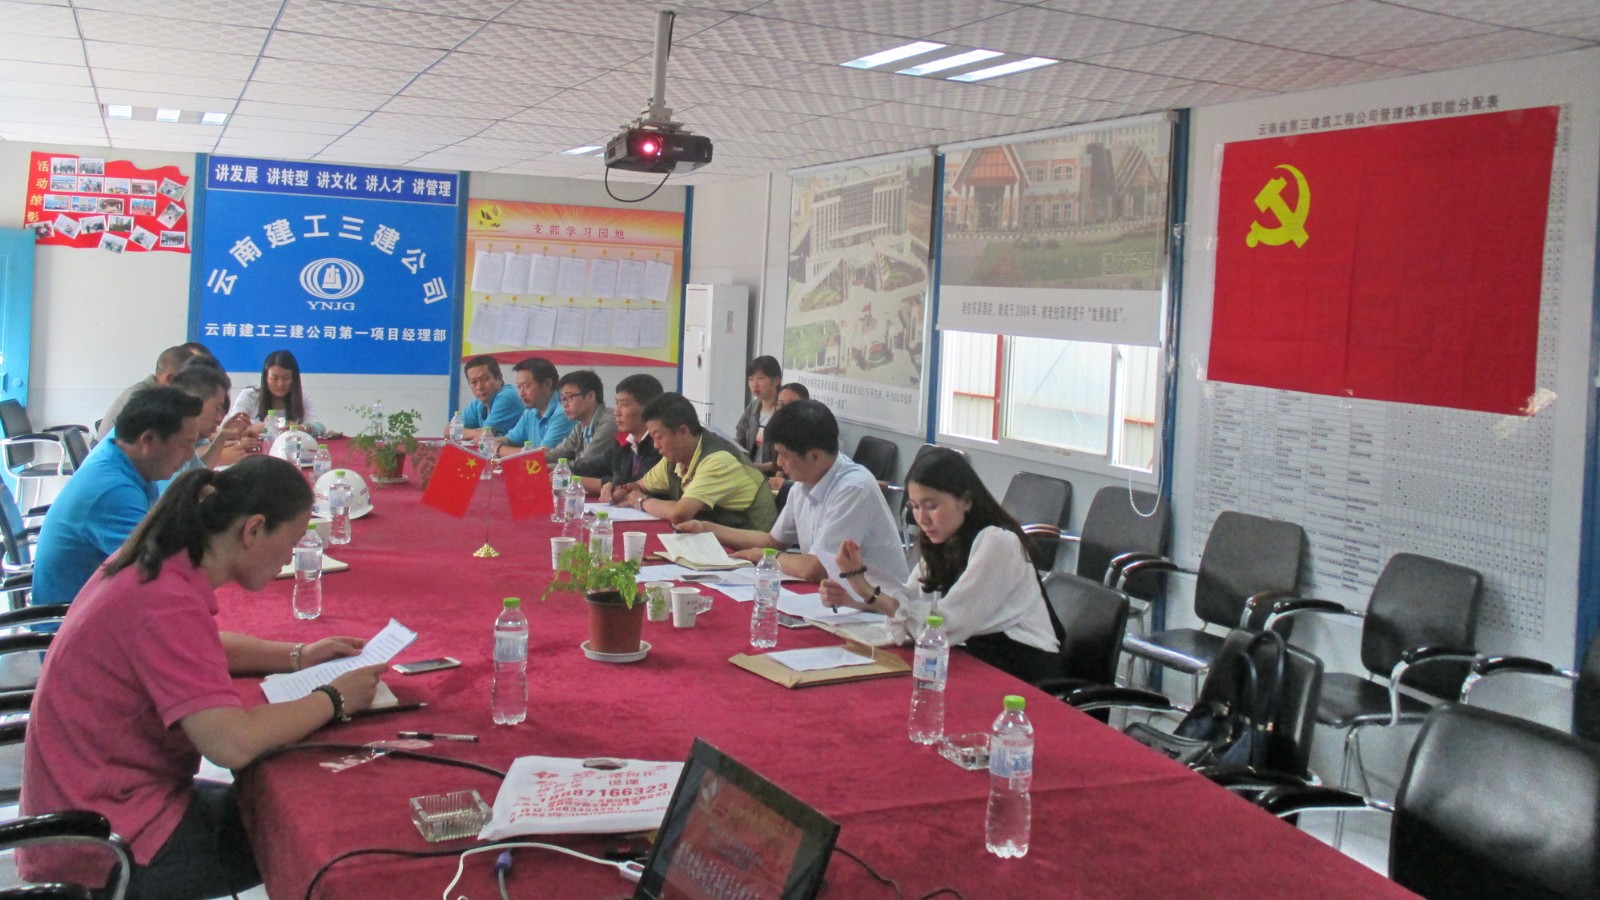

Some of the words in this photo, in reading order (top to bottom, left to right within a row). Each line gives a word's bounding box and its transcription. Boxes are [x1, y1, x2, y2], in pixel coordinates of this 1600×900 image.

[27, 160, 49, 223] 活动掠影
[214, 163, 259, 184] 讲发展
[266, 167, 309, 187] 讲转型
[316, 171, 358, 191] 讲文化
[365, 174, 404, 194] 讲人才
[412, 178, 451, 197] 讲管理
[533, 223, 625, 240] 支部学习园地
[207, 214, 448, 304] 云南建工三建公司
[306, 301, 355, 311] YNJG
[204, 323, 447, 343] 云南建工三建公司第一项目经理部
